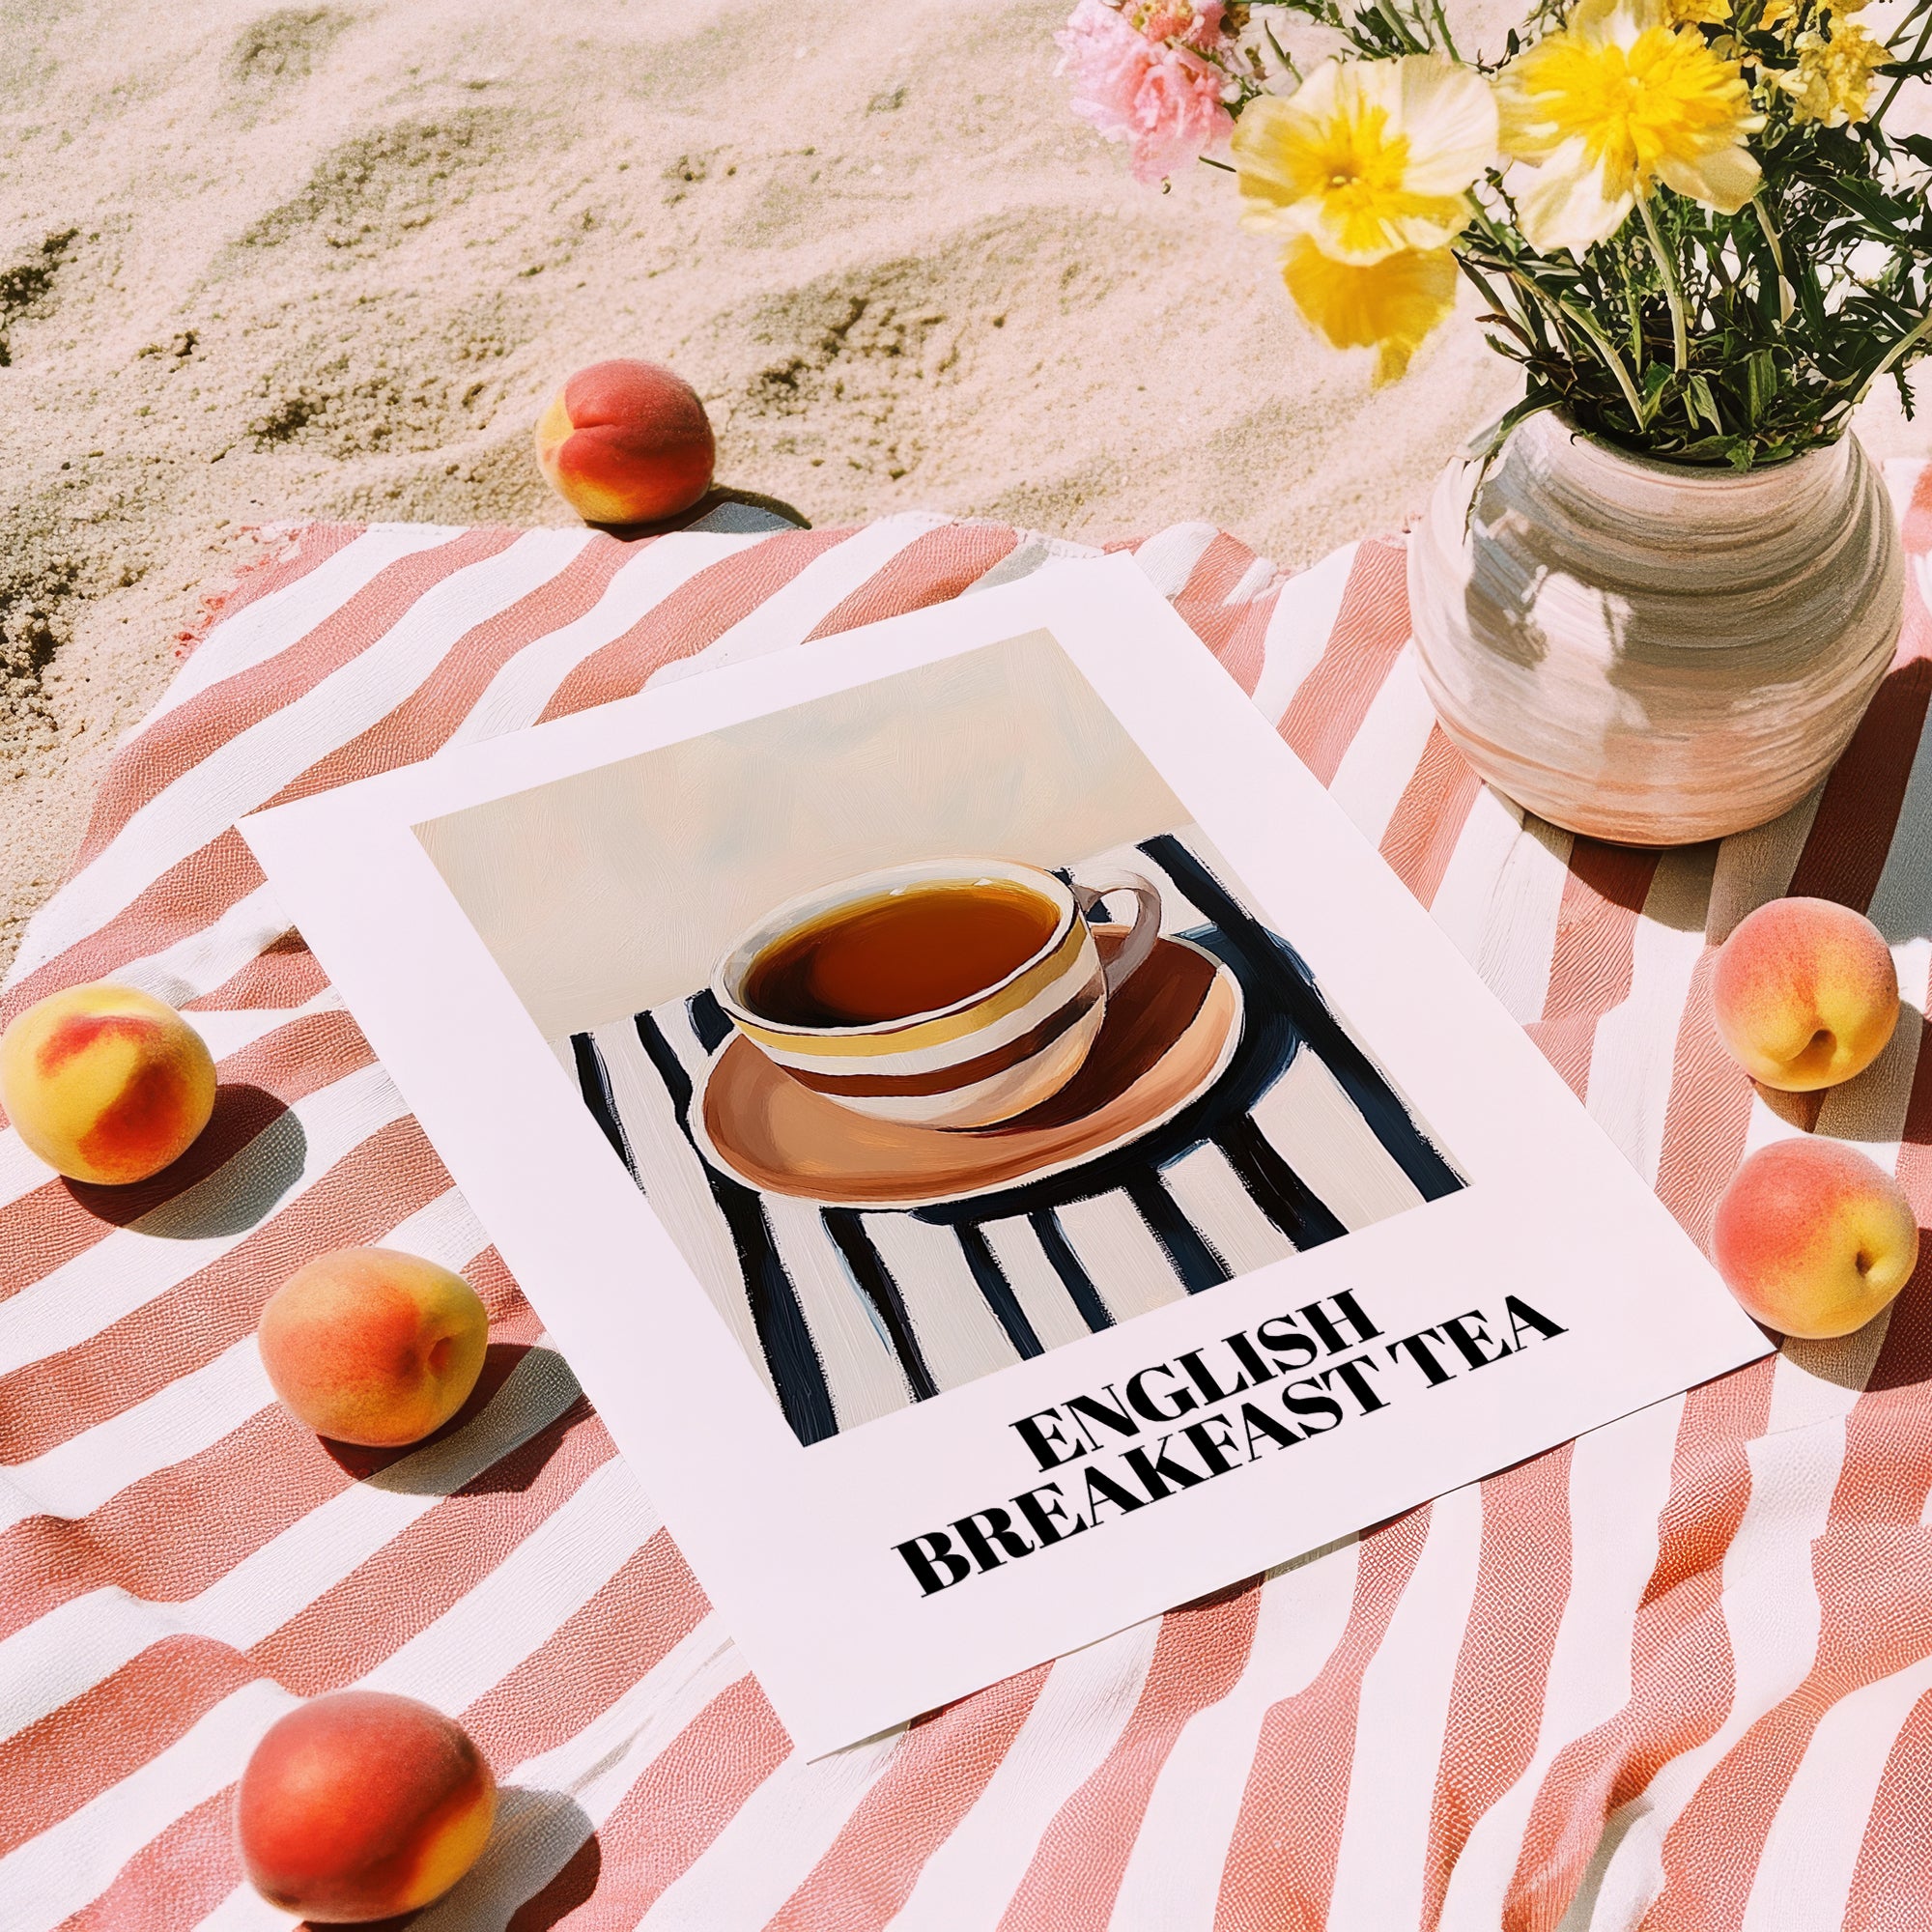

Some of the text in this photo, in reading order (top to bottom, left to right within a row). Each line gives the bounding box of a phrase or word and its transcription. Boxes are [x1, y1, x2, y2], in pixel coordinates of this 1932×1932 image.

[890, 1294, 1570, 1599] BREAKFAST TEA
[1009, 1288, 1385, 1473] ENGLISH
